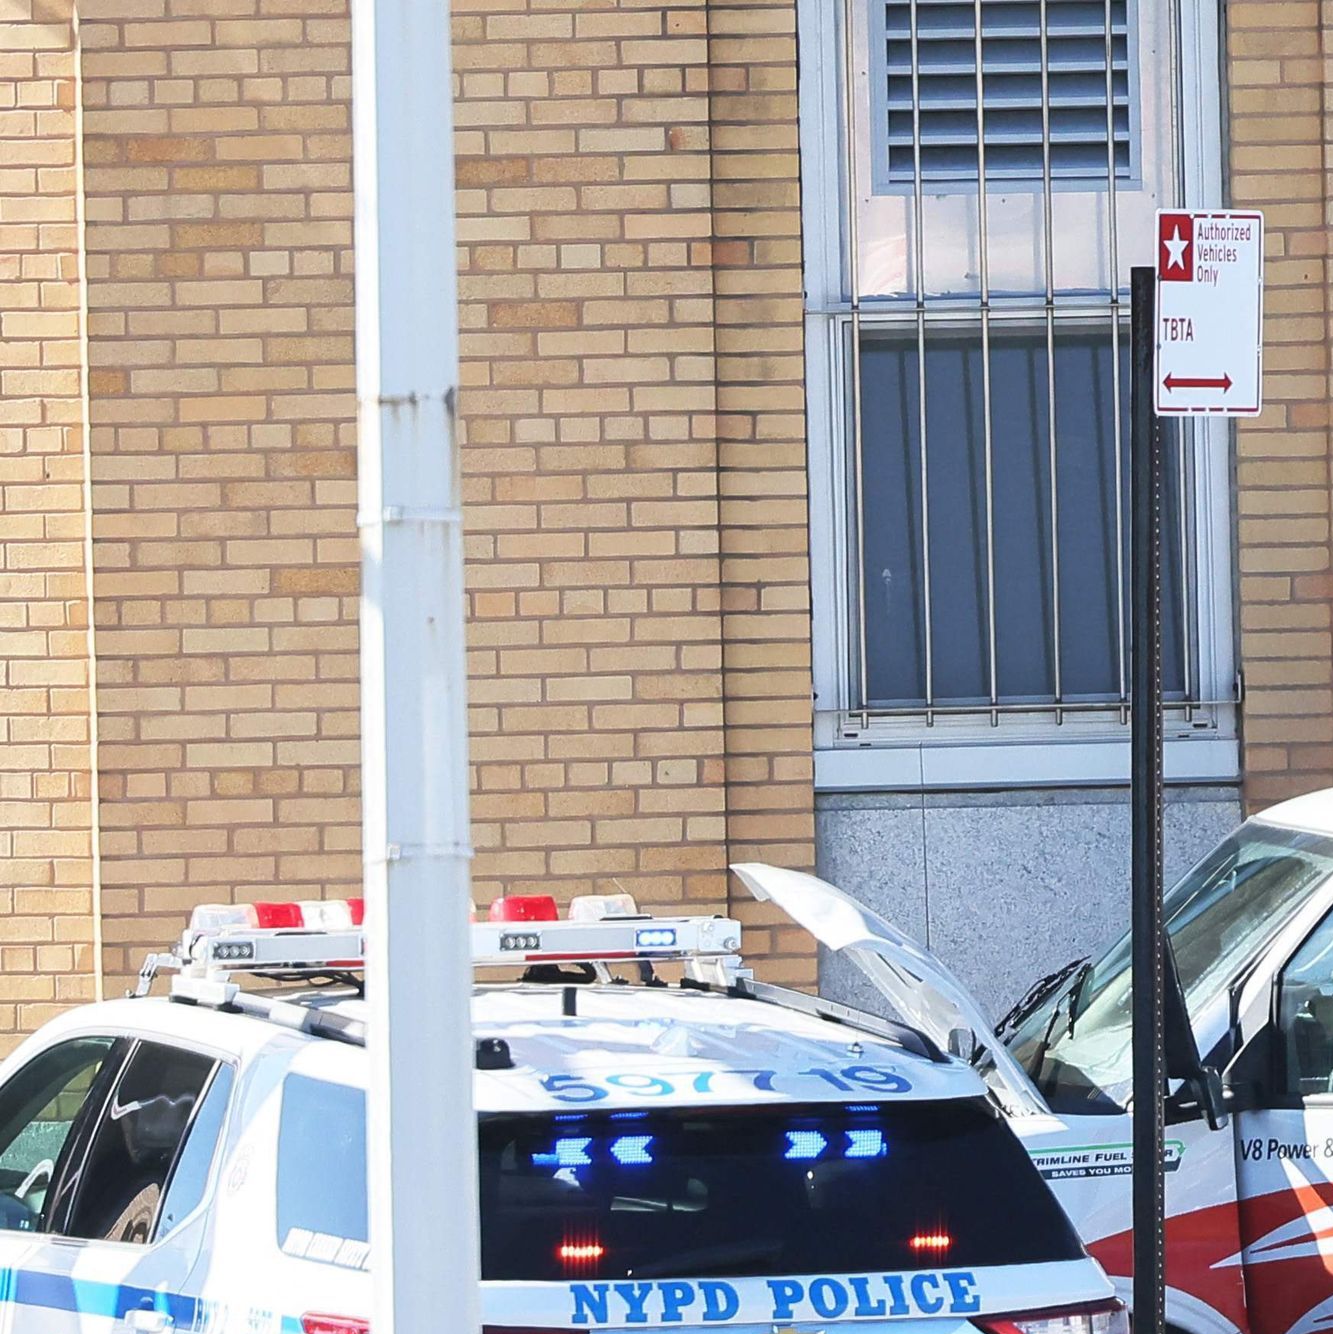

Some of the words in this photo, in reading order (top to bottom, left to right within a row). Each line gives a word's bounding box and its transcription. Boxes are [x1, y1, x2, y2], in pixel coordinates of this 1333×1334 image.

[1197, 223, 1251, 241] Authorized
[1197, 244, 1238, 262] Vehicles
[1197, 265, 1219, 287] Only
[1163, 318, 1194, 341] TBTA
[1094, 1152, 1128, 1163] FUEL
[1240, 1138, 1263, 1160] V8
[1267, 1138, 1319, 1161] Power
[1051, 1167, 1086, 1178] SAVES
[1089, 1166, 1111, 1176] YOU
[1114, 1166, 1133, 1175] MO
[570, 1279, 740, 1324] NYPD
[767, 1271, 981, 1320] POLICE
